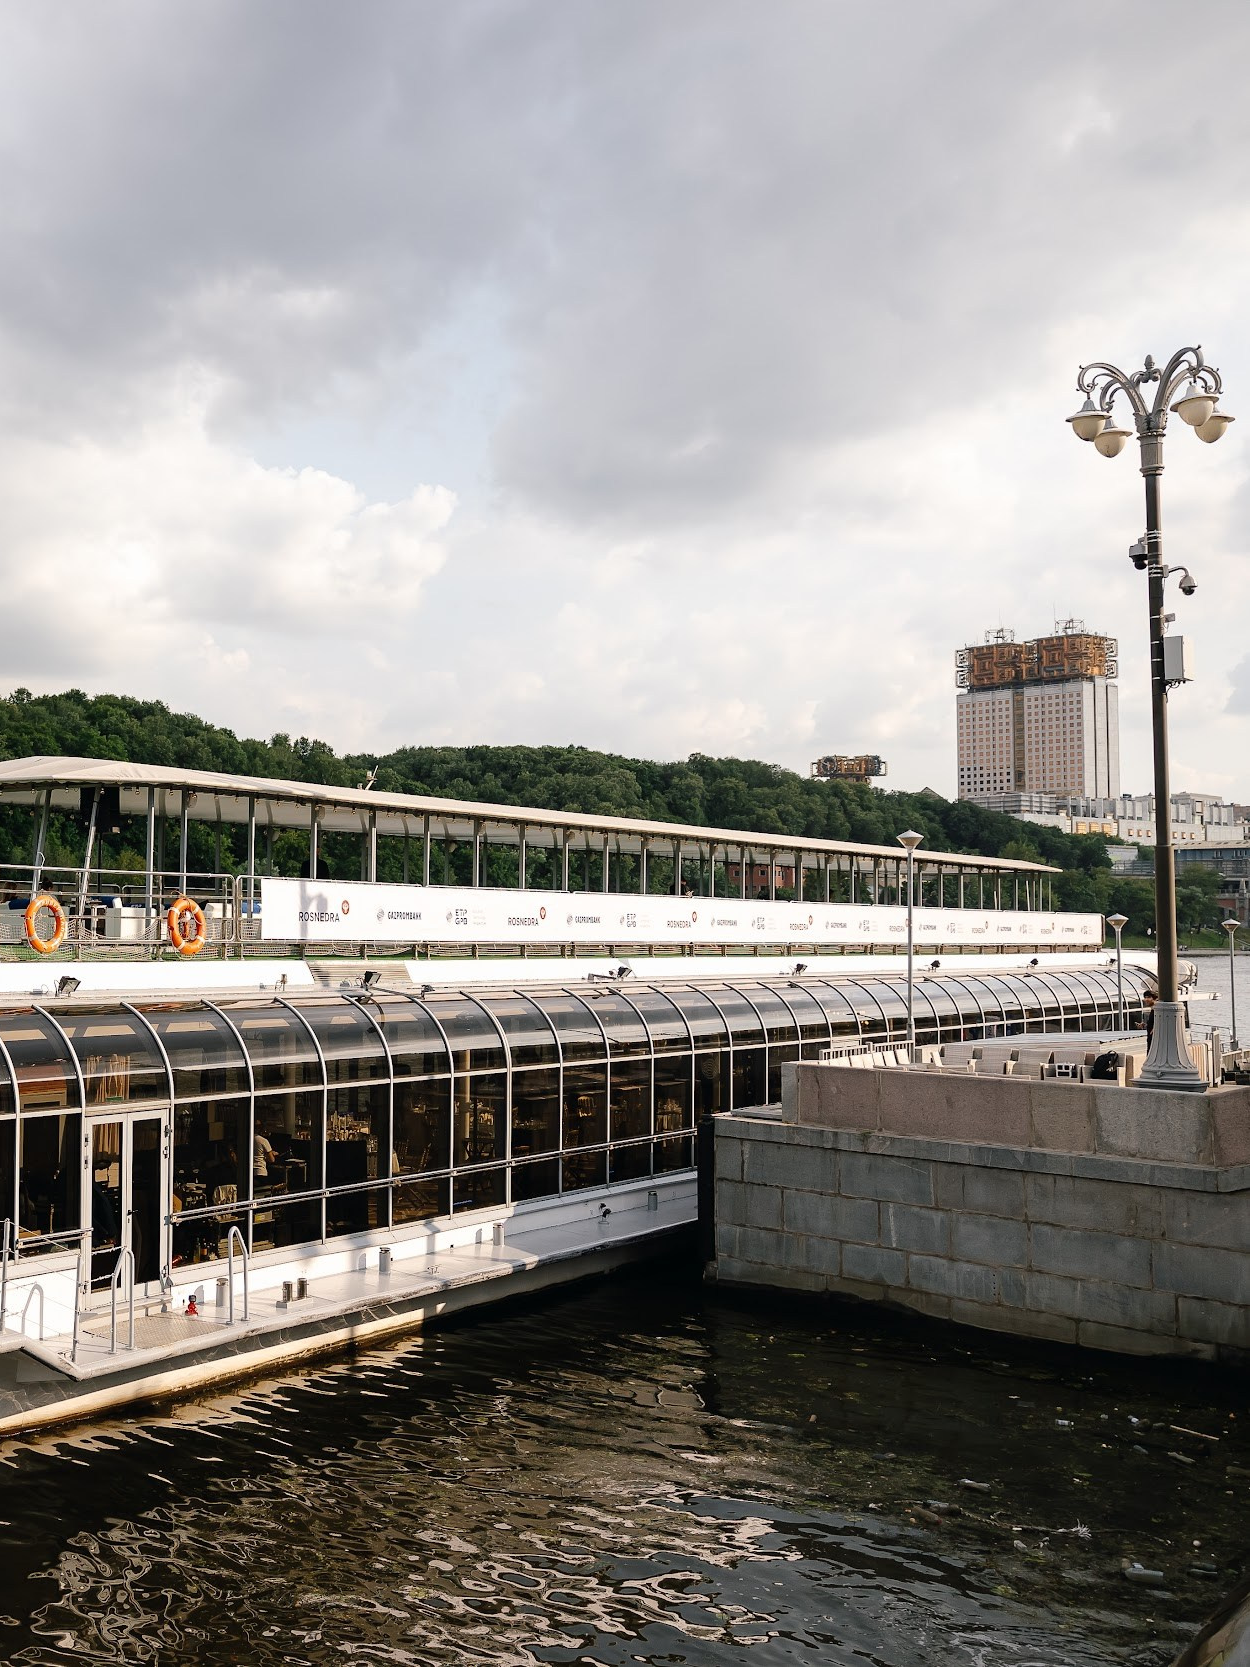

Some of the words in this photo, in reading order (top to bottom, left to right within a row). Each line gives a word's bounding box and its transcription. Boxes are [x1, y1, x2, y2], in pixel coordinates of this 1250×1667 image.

[299, 911, 340, 922] ROSNEDRA
[387, 911, 422, 920] GAZPROMBANK
[507, 917, 539, 926] ROSNEDRA
[667, 920, 692, 928] ROSNEDRA
